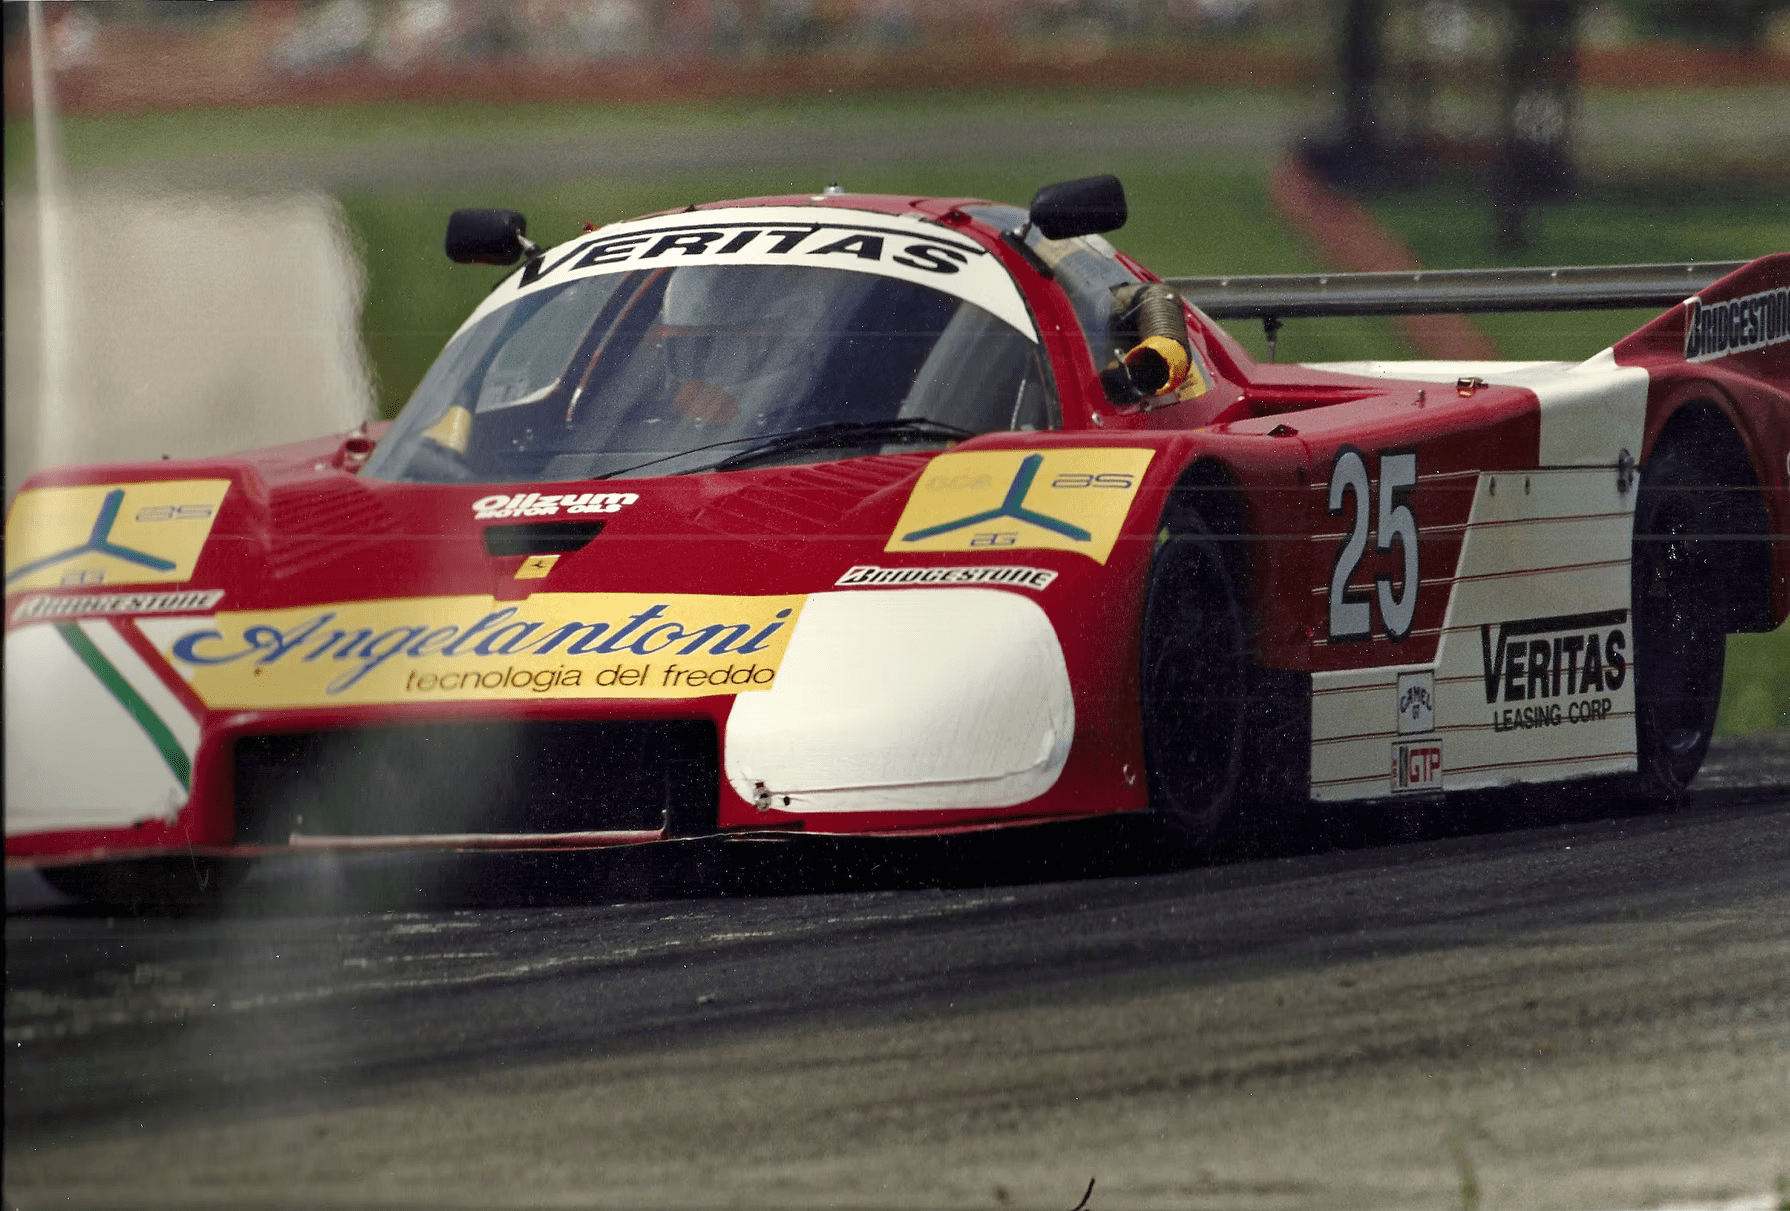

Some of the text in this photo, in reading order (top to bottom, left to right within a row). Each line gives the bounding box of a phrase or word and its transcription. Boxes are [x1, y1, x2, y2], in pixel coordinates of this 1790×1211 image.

[517, 222, 985, 290] VERITAS
[1685, 288, 1790, 359] BRIDGESTON
[567, 504, 622, 514] OILS
[1328, 445, 1419, 643] 25
[842, 566, 1048, 587] BRIDGESTONE
[172, 604, 792, 695] Angelantoni
[1481, 609, 1628, 704] VERITAS
[406, 664, 775, 693] tecnologia del freddo
[1494, 698, 1613, 732] LEASING CORP
[1409, 747, 1441, 782] GTP
